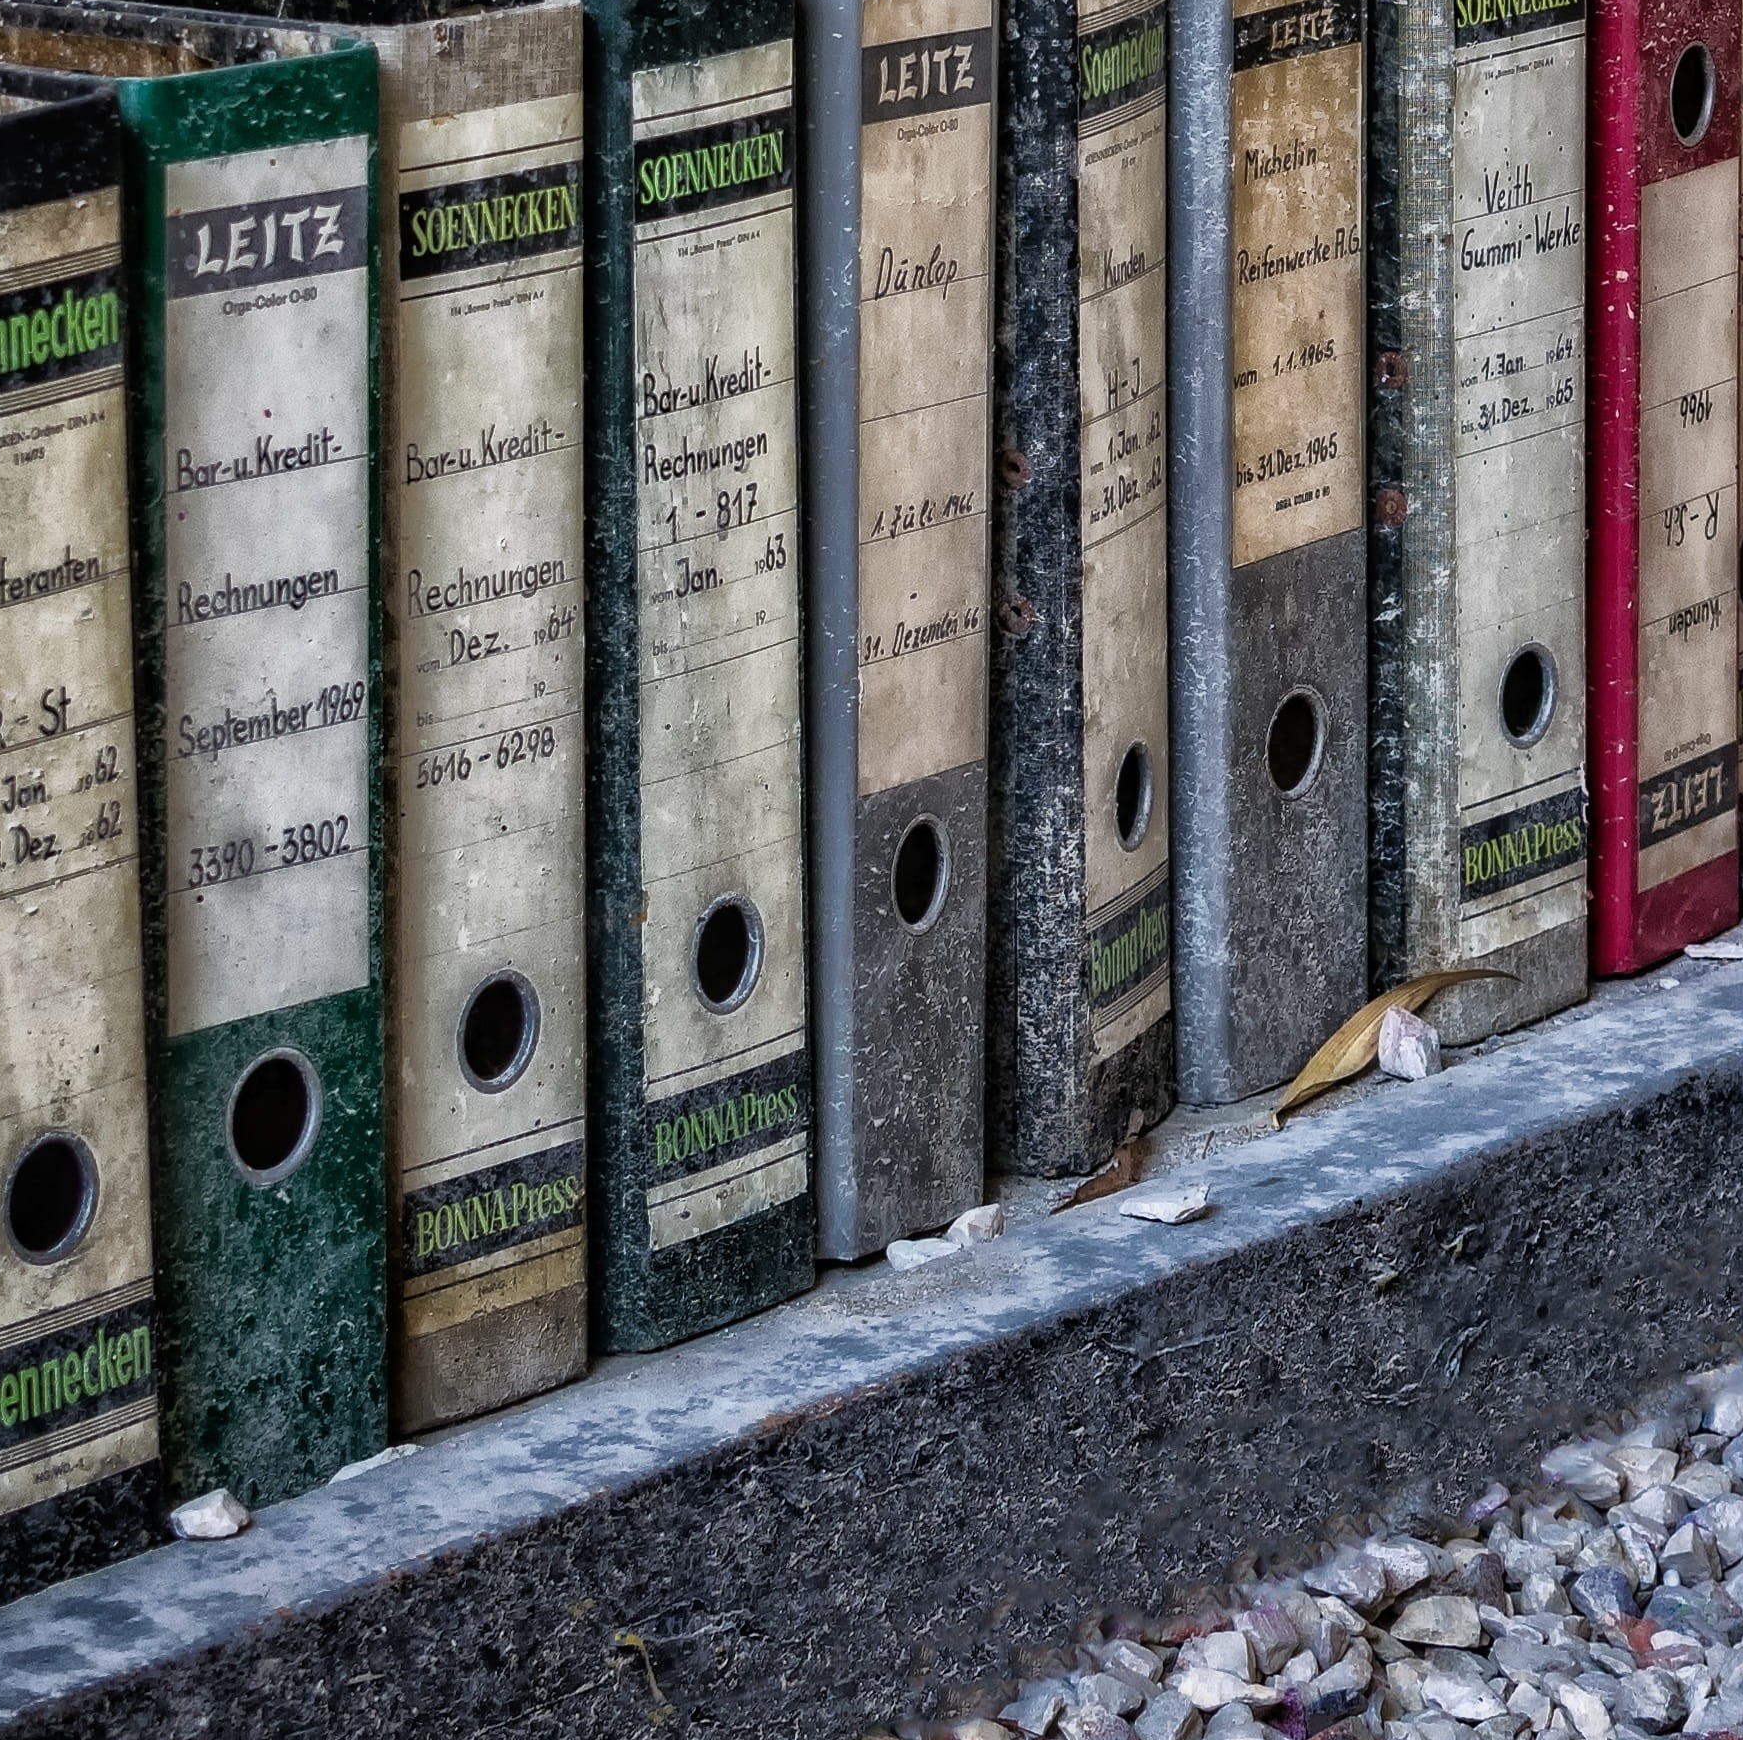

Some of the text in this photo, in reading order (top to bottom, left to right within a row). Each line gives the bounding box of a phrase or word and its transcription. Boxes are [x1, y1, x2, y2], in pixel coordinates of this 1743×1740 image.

[1270, 8, 1335, 52] LEITZ
[877, 43, 976, 105] LEITZ
[1081, 20, 1165, 101] Soennecken
[640, 128, 785, 205] SOENNECKEN
[1243, 139, 1317, 186] Michelin
[1483, 163, 1533, 214] Veith
[193, 202, 345, 279] LEITZ
[411, 183, 580, 258] SOENNECKEN
[1104, 244, 1146, 289] Kunden
[1237, 234, 1331, 287] Reifenwerke
[1107, 369, 1119, 411] H
[1234, 368, 1258, 390] vom
[1460, 375, 1479, 388] vom
[1461, 419, 1475, 435] bis
[644, 432, 768, 486] Rechnungen
[1235, 432, 1339, 488] bis 1965
[716, 482, 758, 529] 817
[177, 568, 340, 624] Rechnungen
[407, 558, 566, 617] Rechnungen
[1668, 597, 1722, 643] Kunden
[38, 686, 72, 737] St
[177, 680, 365, 761] September 1969
[497, 724, 556, 770] 6298
[1651, 761, 1726, 834] LEITZ
[281, 815, 351, 866] 3802
